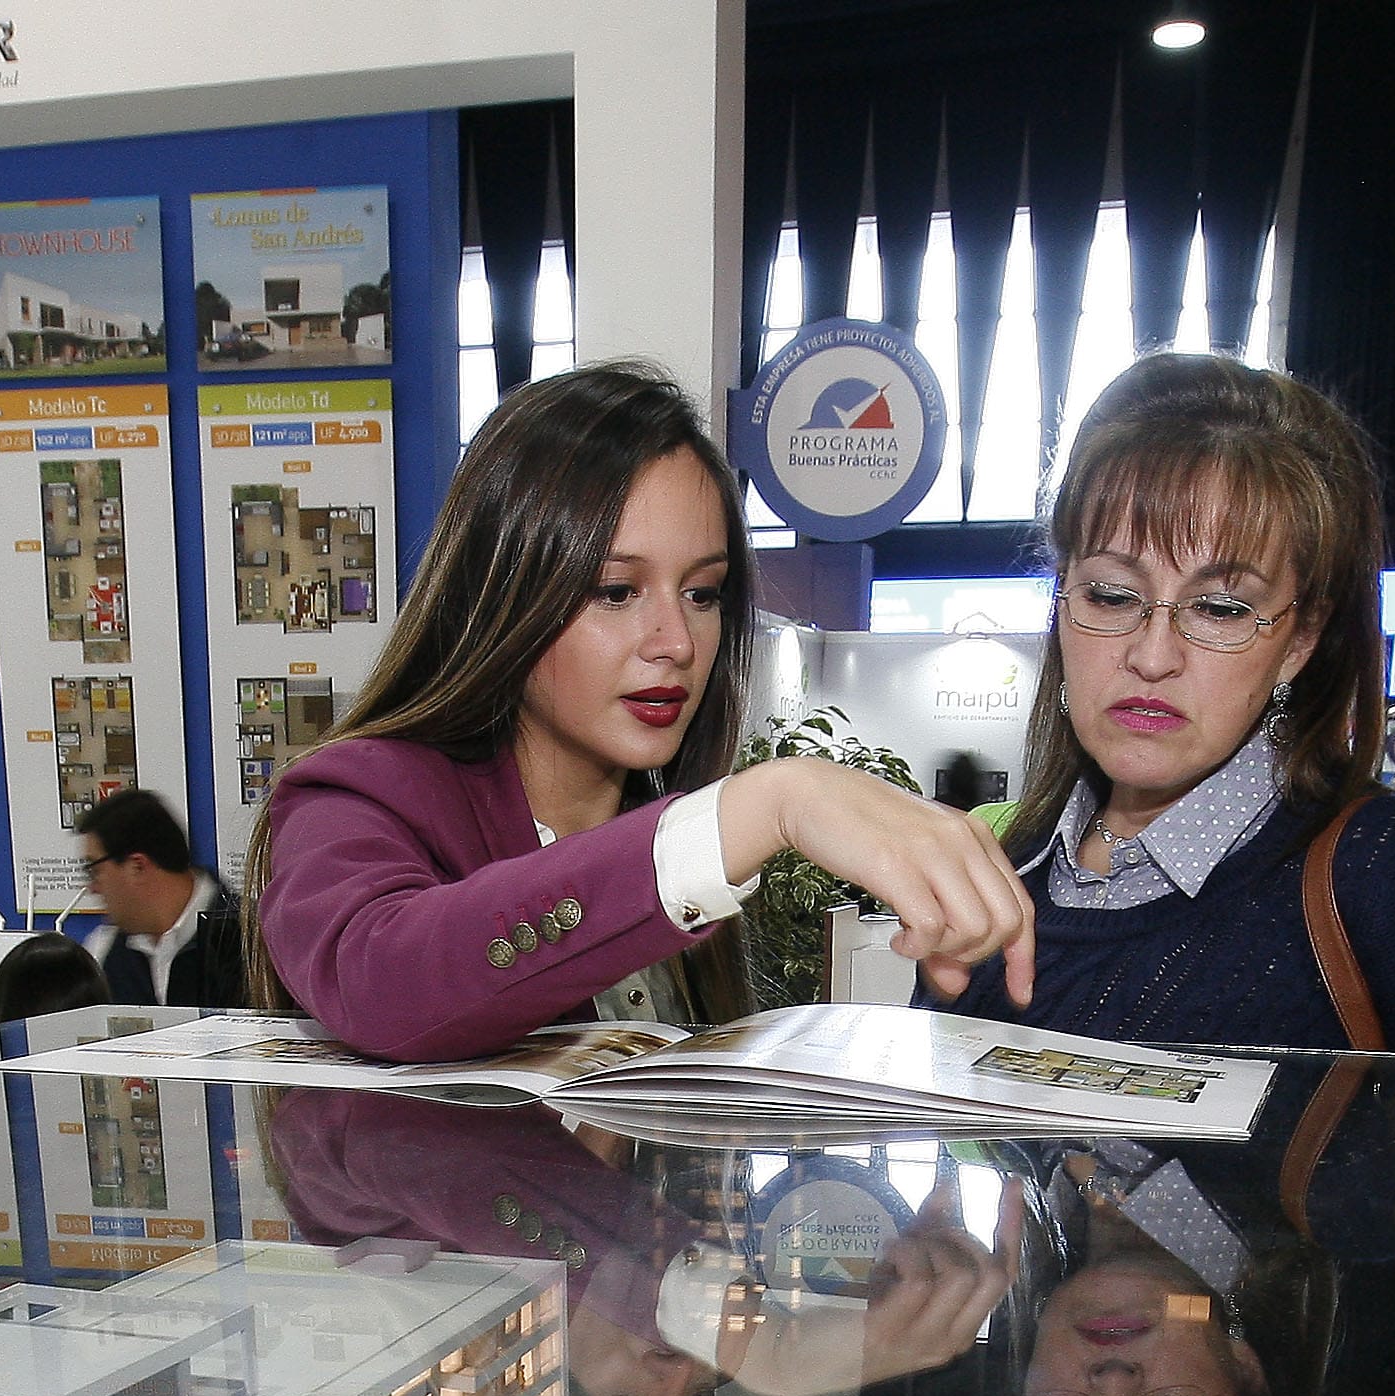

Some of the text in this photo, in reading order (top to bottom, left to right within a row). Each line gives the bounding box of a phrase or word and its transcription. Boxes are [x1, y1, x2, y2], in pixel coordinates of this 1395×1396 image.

[252, 228, 286, 248] San
[751, 393, 769, 424] ESTA
[763, 346, 804, 392] EMPRESA
[805, 331, 834, 350] TIENE
[836, 328, 899, 352] PROYECTOS
[789, 435, 899, 451] PROGRAMA
[788, 452, 898, 467] Buenas Prácticas
[936, 686, 1019, 712] maipú
